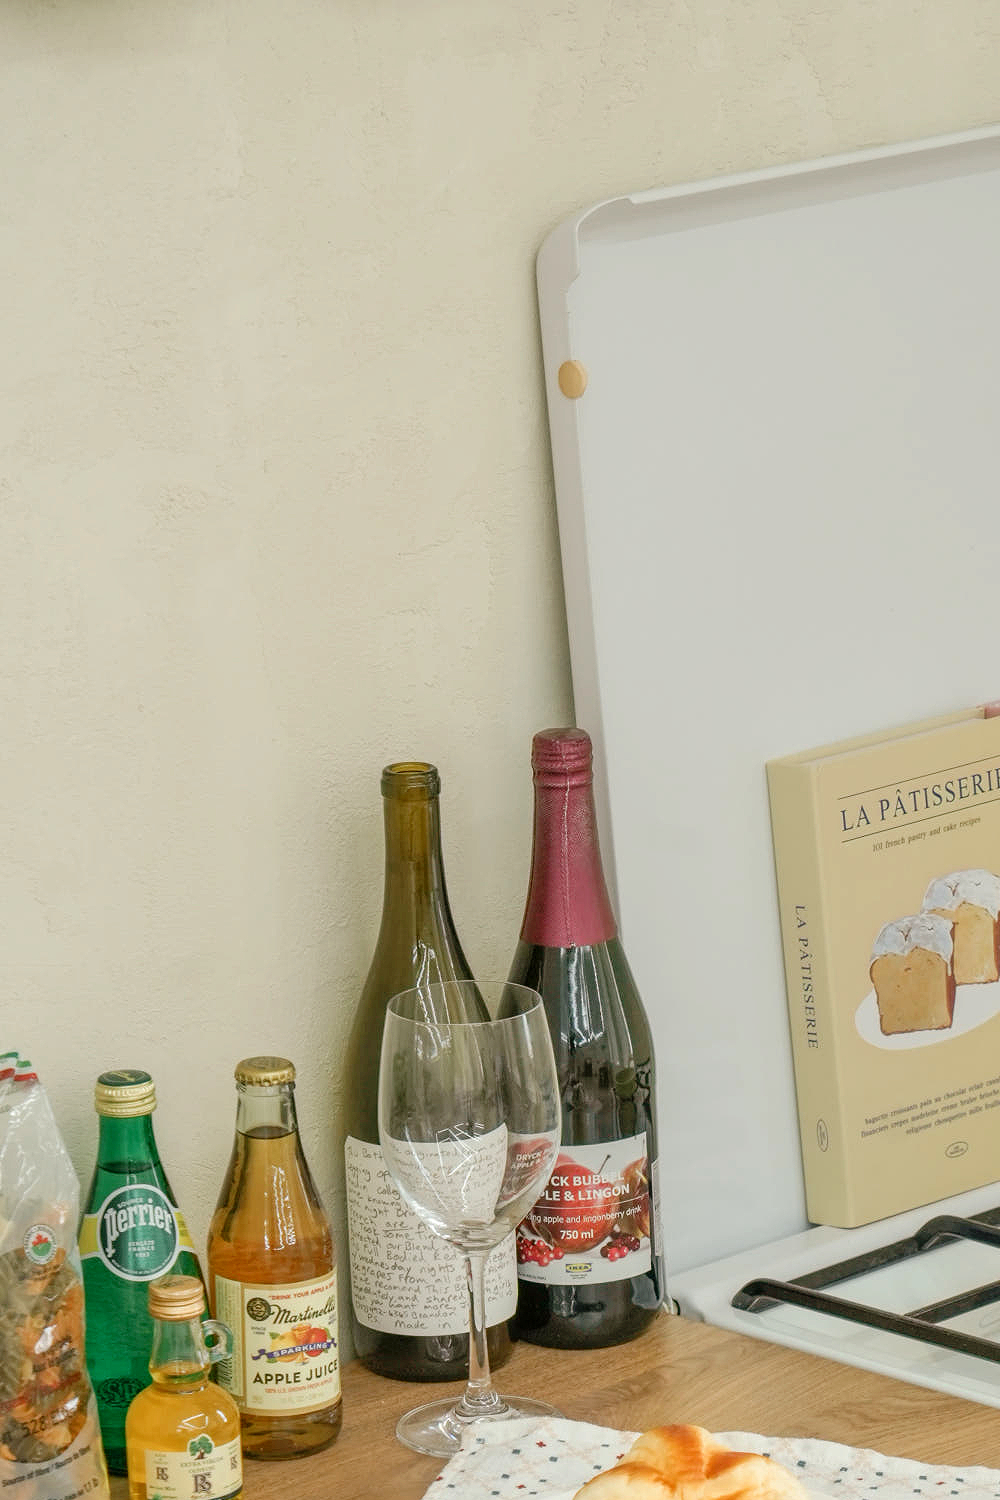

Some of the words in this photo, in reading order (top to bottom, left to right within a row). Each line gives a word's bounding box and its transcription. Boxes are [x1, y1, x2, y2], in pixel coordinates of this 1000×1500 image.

[840, 805, 870, 831] LA
[886, 837, 905, 849] french
[908, 832, 927, 845] pastry
[930, 826, 941, 836] and
[943, 822, 957, 832] cake
[960, 816, 982, 828] recipes
[795, 904, 807, 928] LA
[798, 937, 819, 1049] PÂTISSERIE
[564, 1191, 575, 1202] &
[578, 1184, 630, 1201] LINGON
[543, 1214, 564, 1226] apple
[566, 1214, 581, 1224] and
[583, 1209, 625, 1223] lingonberry
[626, 1204, 642, 1217] drink
[560, 1230, 579, 1240] 750
[581, 1228, 594, 1239] ml
[567, 1263, 591, 1272] IKEA
[395, 1319, 428, 1330] Made
[271, 1342, 328, 1358] SPARKLING
[252, 1371, 301, 1385] APPLE
[305, 1359, 338, 1381] JUICE
